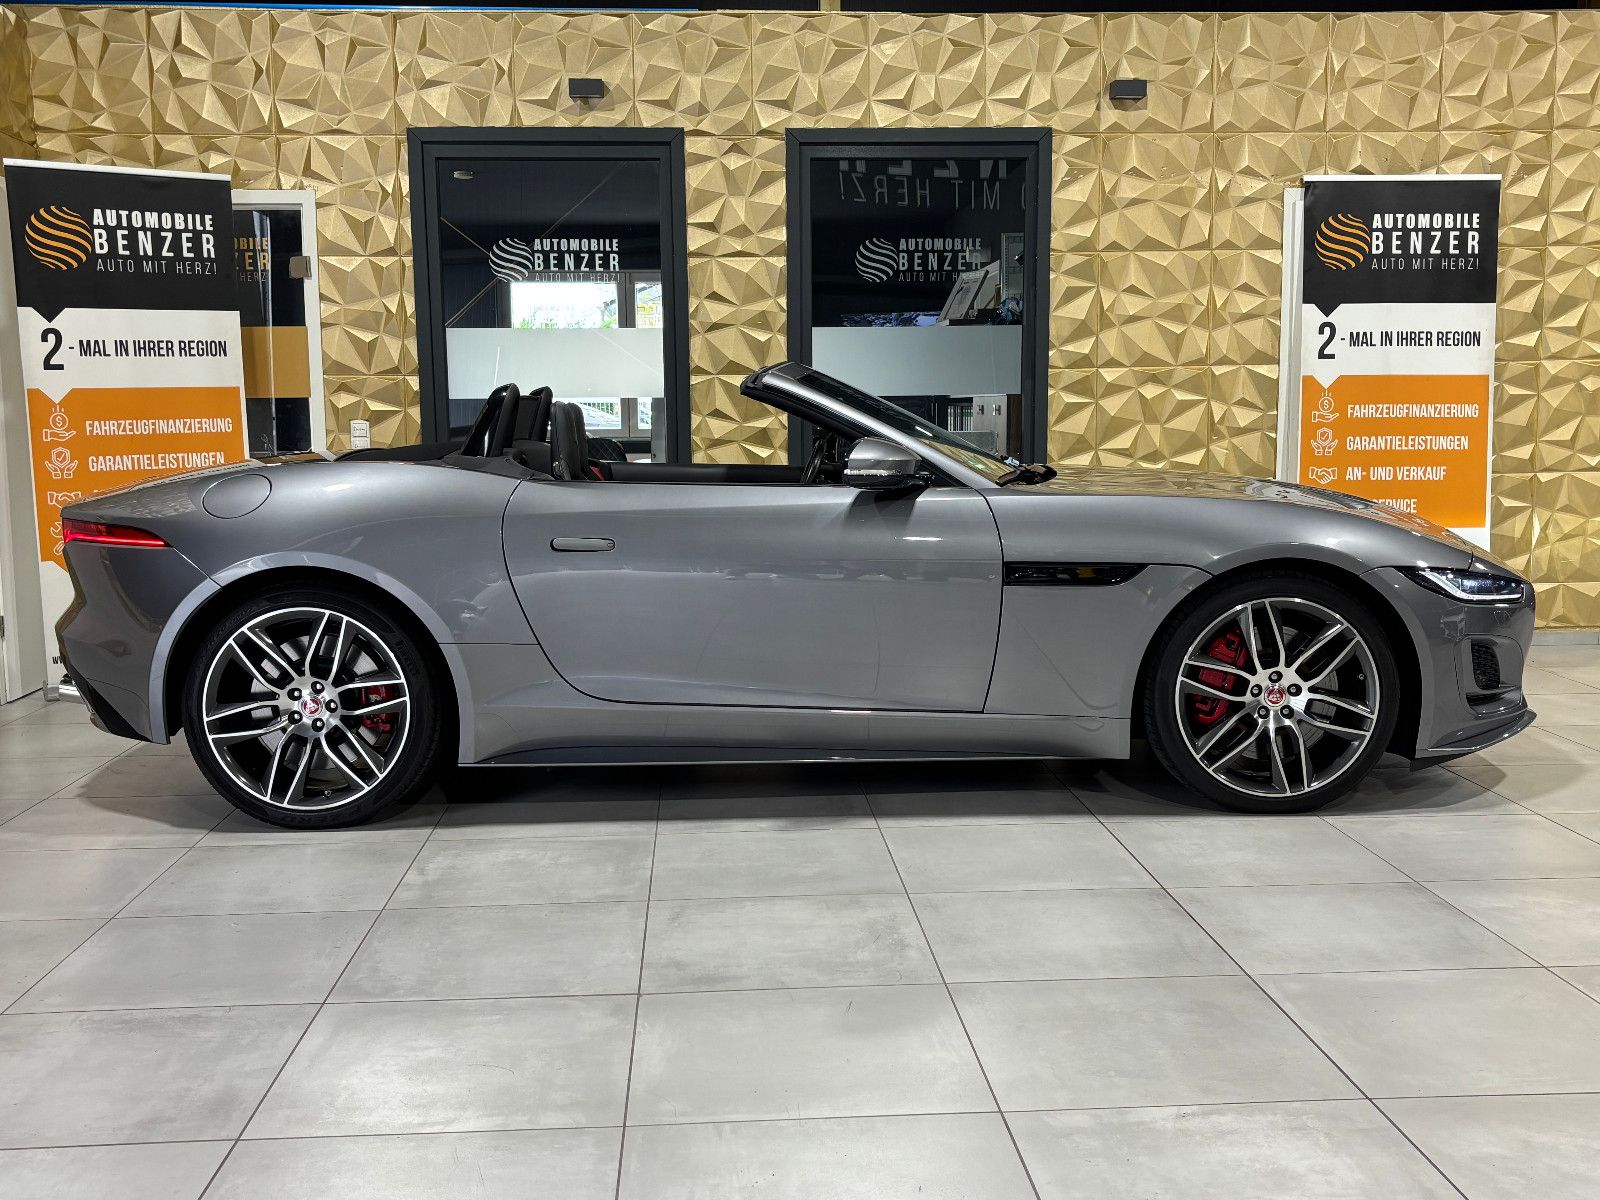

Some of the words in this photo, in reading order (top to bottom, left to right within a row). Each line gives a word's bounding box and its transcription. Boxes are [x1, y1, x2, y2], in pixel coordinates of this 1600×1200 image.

[93, 208, 214, 231] AUTOMOBILE
[1372, 213, 1480, 229] AUTOMOBILE
[93, 228, 216, 259] BENZER
[533, 238, 619, 252] AUTOMOBILE
[899, 237, 982, 251] AUTOMOBILE
[1371, 231, 1480, 255] BENZER
[97, 258, 135, 273] AUTO
[143, 260, 167, 274] MIT
[176, 261, 217, 275] HERZ!
[534, 252, 620, 272] BENZER
[899, 252, 981, 271] BENZER
[1371, 258, 1405, 270] AUTO
[1412, 258, 1434, 270] MIT
[1441, 257, 1480, 270] HERZ!
[535, 272, 561, 283] AUTO
[566, 272, 584, 283] MIT
[899, 272, 925, 282] AUTO
[929, 272, 947, 282] MIT
[40, 327, 65, 371] 2
[78, 339, 112, 358] MAL
[114, 339, 129, 357] IN
[132, 339, 175, 358] IHRER
[178, 340, 228, 358] REGION
[1317, 321, 1337, 360] 2
[1349, 331, 1377, 347] MAL
[1380, 331, 1393, 347] IN
[1396, 331, 1433, 347] IHRER
[1436, 331, 1481, 347] REGION
[1347, 404, 1480, 419] FAHRZEUGFINANZIERUNG
[85, 417, 233, 436] FAHRZEUGFINANZIERUNG
[1346, 436, 1469, 451] GARANTIELEISTUNGEN
[88, 452, 225, 472] GARANTIELEISTUNGEN
[1345, 466, 1367, 481] AN-
[1370, 466, 1393, 480] UND
[1396, 466, 1447, 481] VERKAUF
